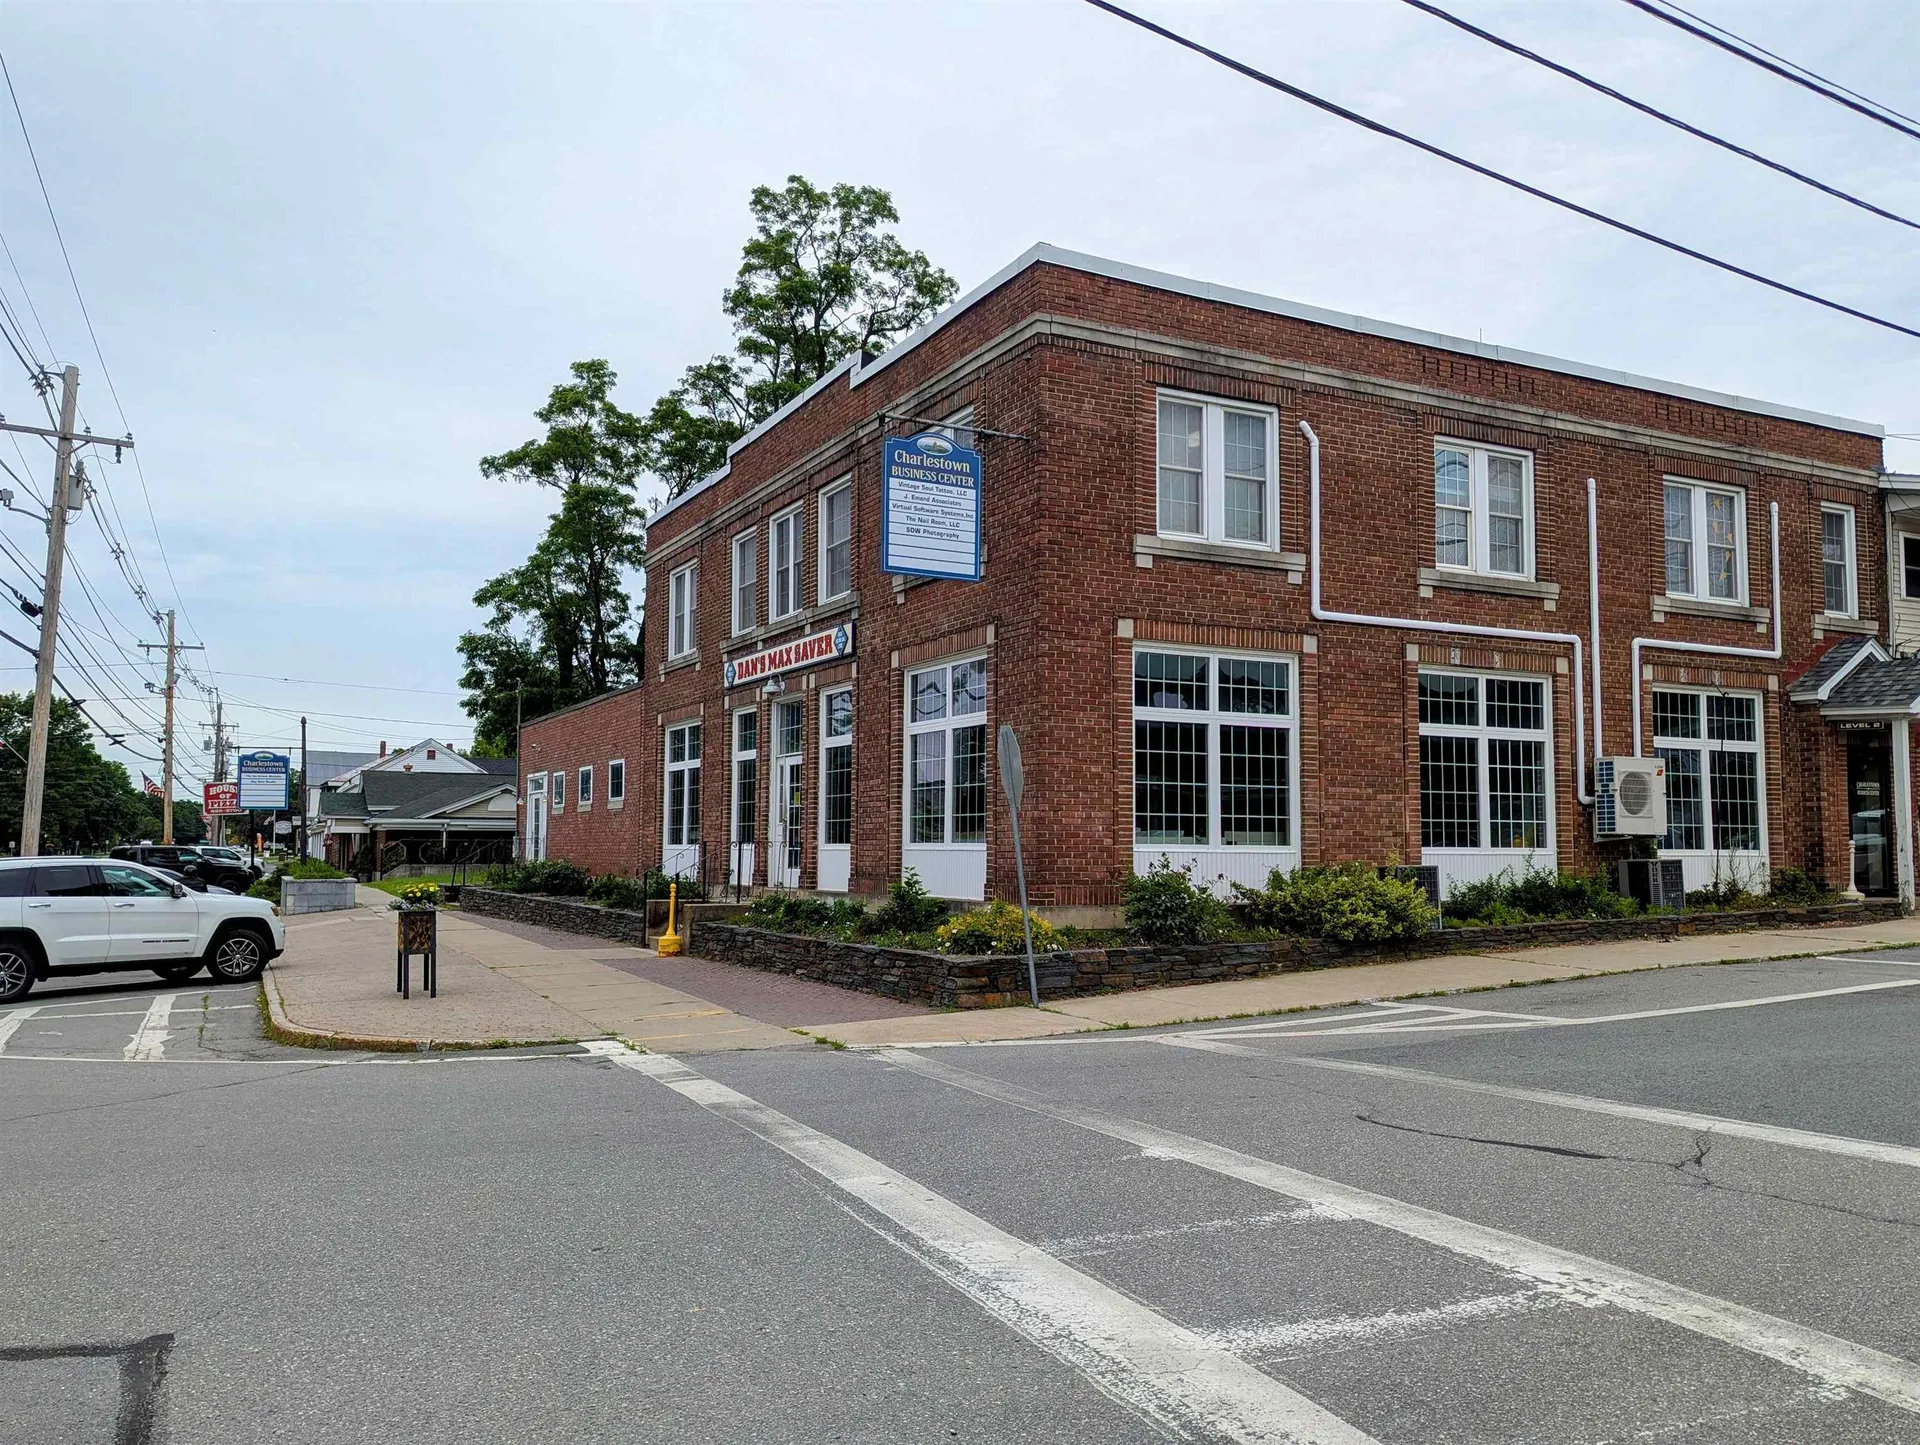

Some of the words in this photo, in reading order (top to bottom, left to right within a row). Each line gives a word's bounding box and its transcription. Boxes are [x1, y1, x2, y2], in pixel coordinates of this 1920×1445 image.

[894, 449, 970, 474] Charlestown
[891, 465, 937, 482] BUSINESS
[938, 472, 975, 487] CENTER
[897, 481, 920, 490] Vintage
[935, 486, 955, 495] Tattoo,
[956, 489, 968, 497] LLC
[891, 502, 912, 511] Virtual
[913, 505, 940, 514] Software
[931, 497, 962, 507] Associates
[922, 528, 960, 540] Photography
[737, 656, 766, 680] DAN'S
[767, 646, 792, 672] MAX
[793, 634, 833, 664] SAVER
